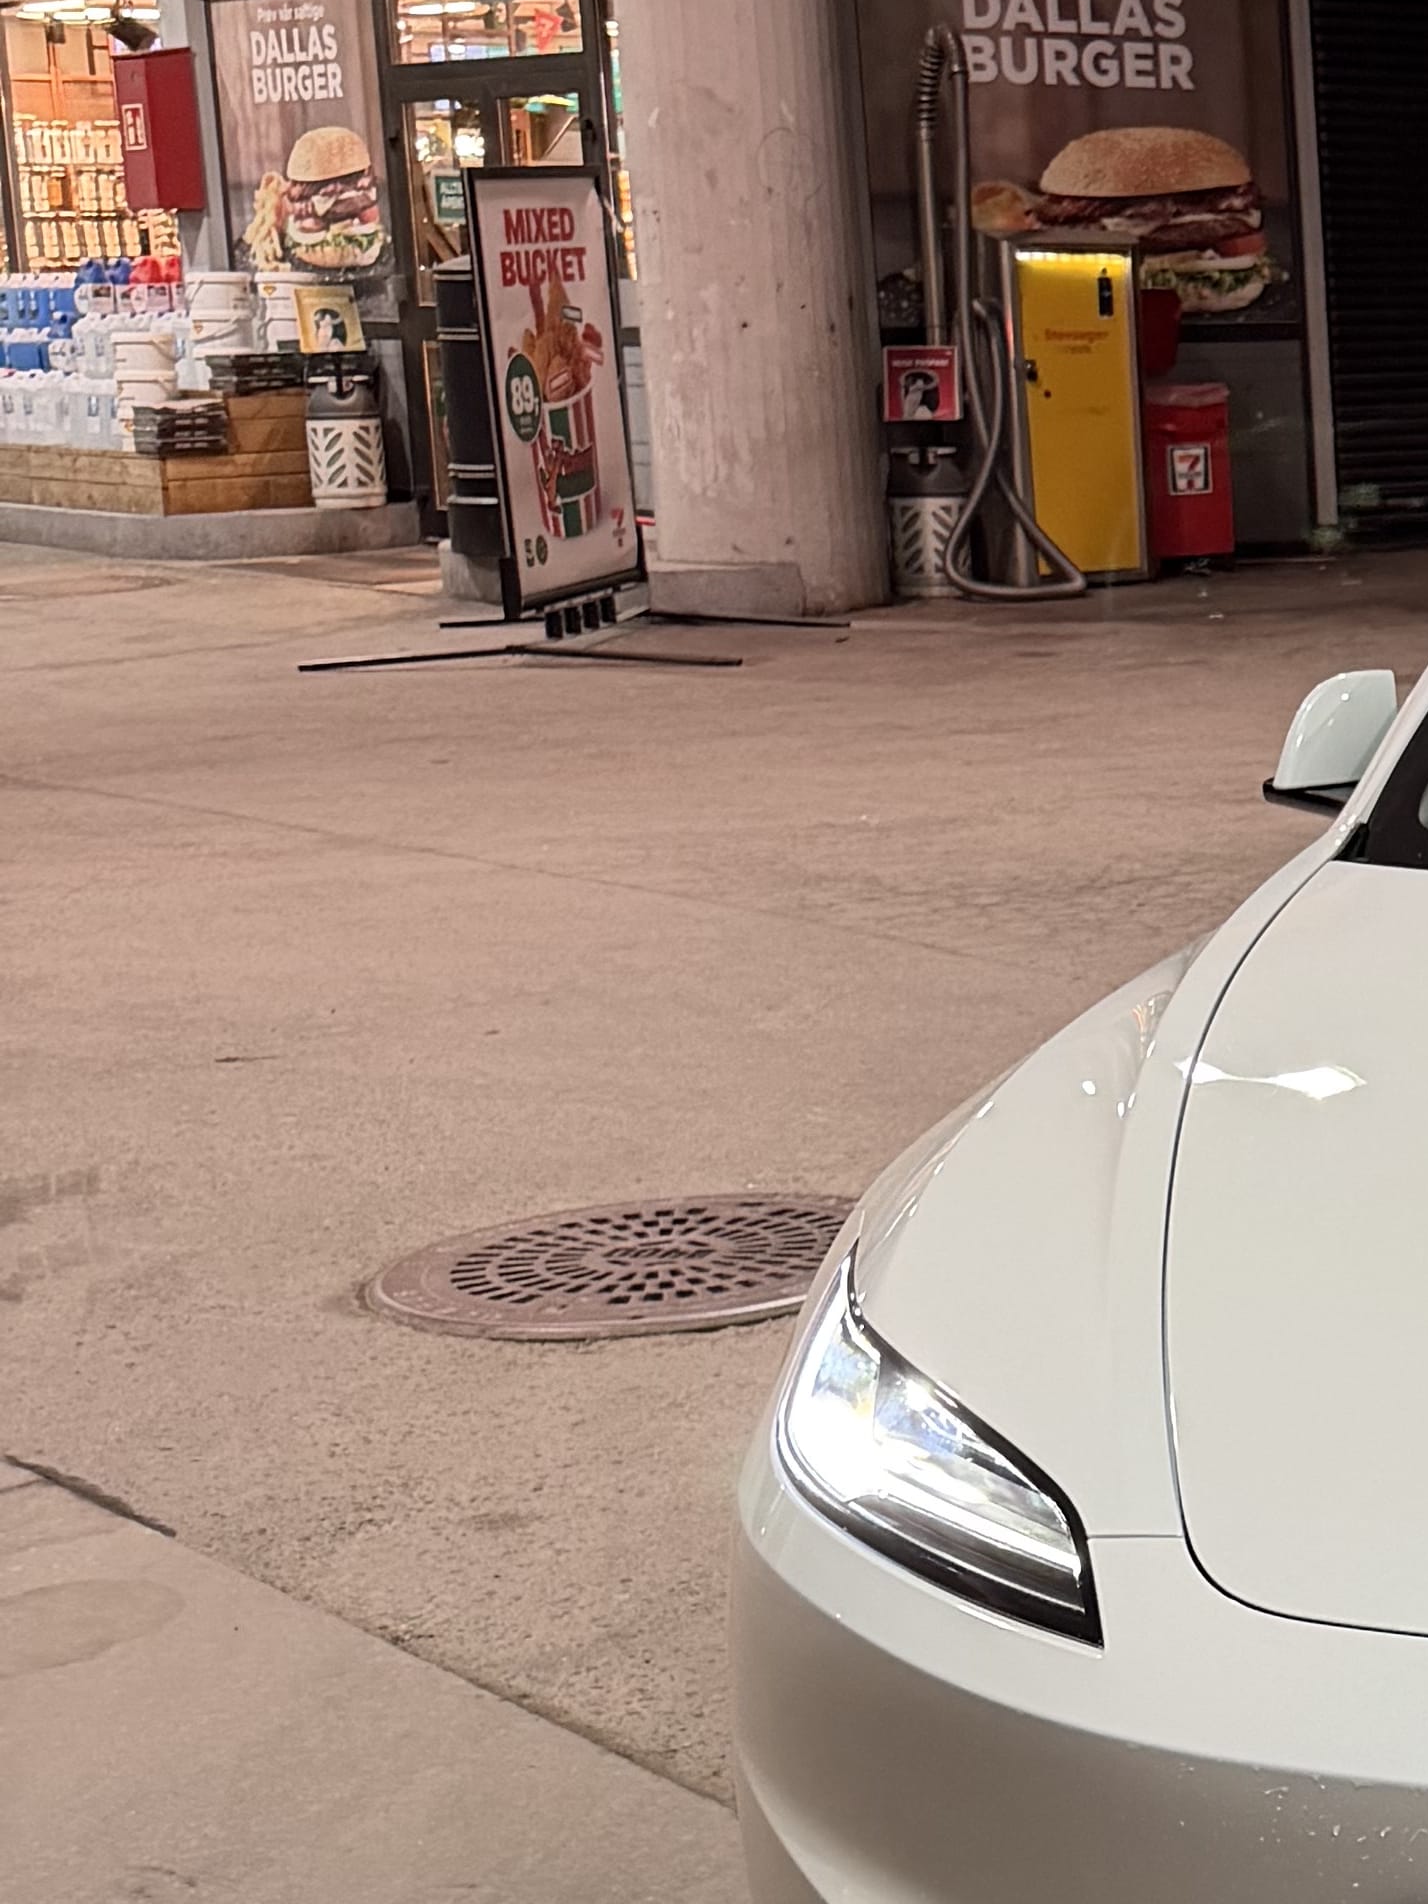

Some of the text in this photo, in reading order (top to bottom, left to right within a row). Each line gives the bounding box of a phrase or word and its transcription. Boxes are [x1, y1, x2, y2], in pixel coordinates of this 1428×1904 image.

[250, 24, 338, 66] DALLAS
[961, 34, 1196, 90] BURGER
[252, 62, 344, 104] BURGER
[503, 208, 575, 245] MIXED
[500, 247, 586, 287] BUCKET
